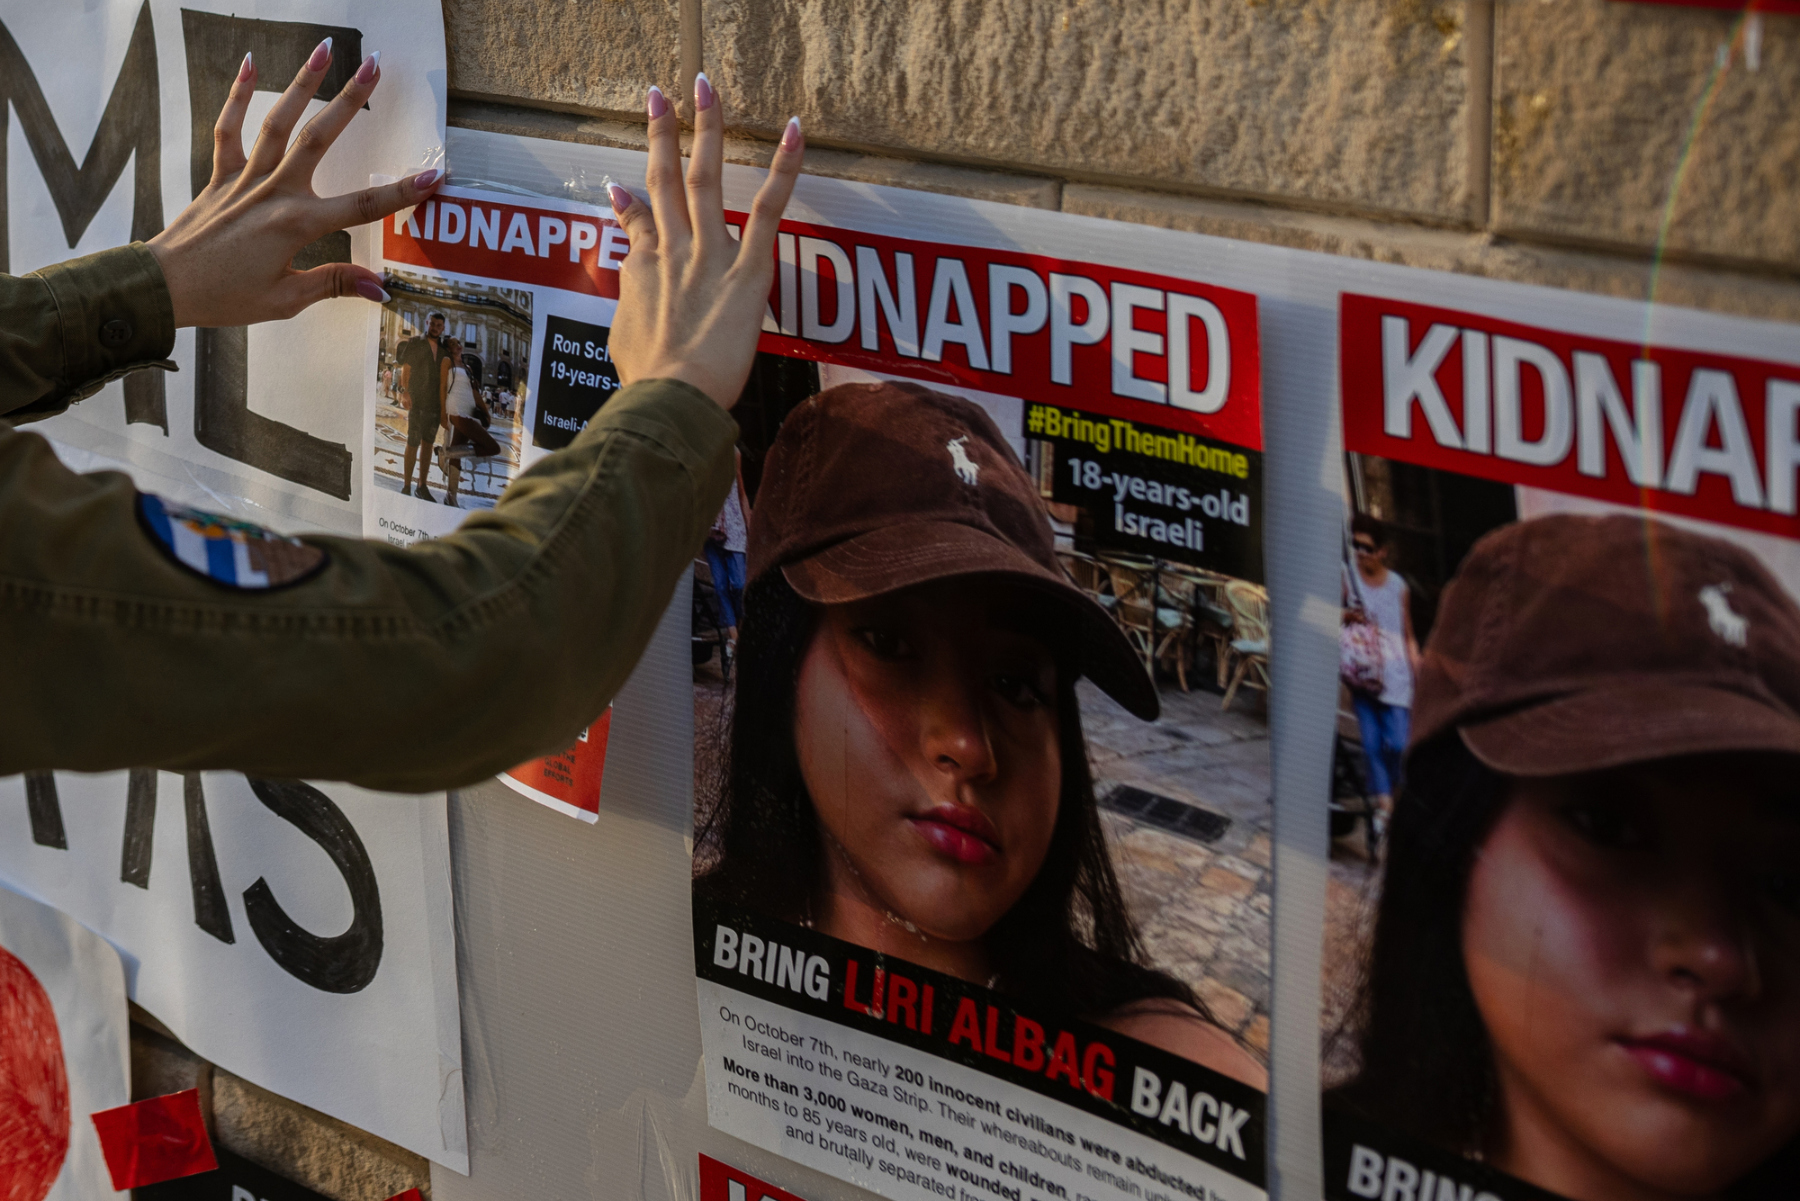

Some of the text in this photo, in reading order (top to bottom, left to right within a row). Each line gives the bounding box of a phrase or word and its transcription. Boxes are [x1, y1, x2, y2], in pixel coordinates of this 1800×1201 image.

[394, 200, 630, 271] KIDNAPPE
[553, 333, 581, 356] Ron
[727, 224, 1231, 414] IDNAPPED
[1028, 405, 1248, 479] #BringThemHome
[1068, 458, 1250, 527] 18-years-old
[1115, 502, 1203, 551] Israeli
[713, 924, 830, 1003] BRING
[844, 959, 1117, 1104] LIRI ALBAG
[1132, 1067, 1249, 1159] BACK
